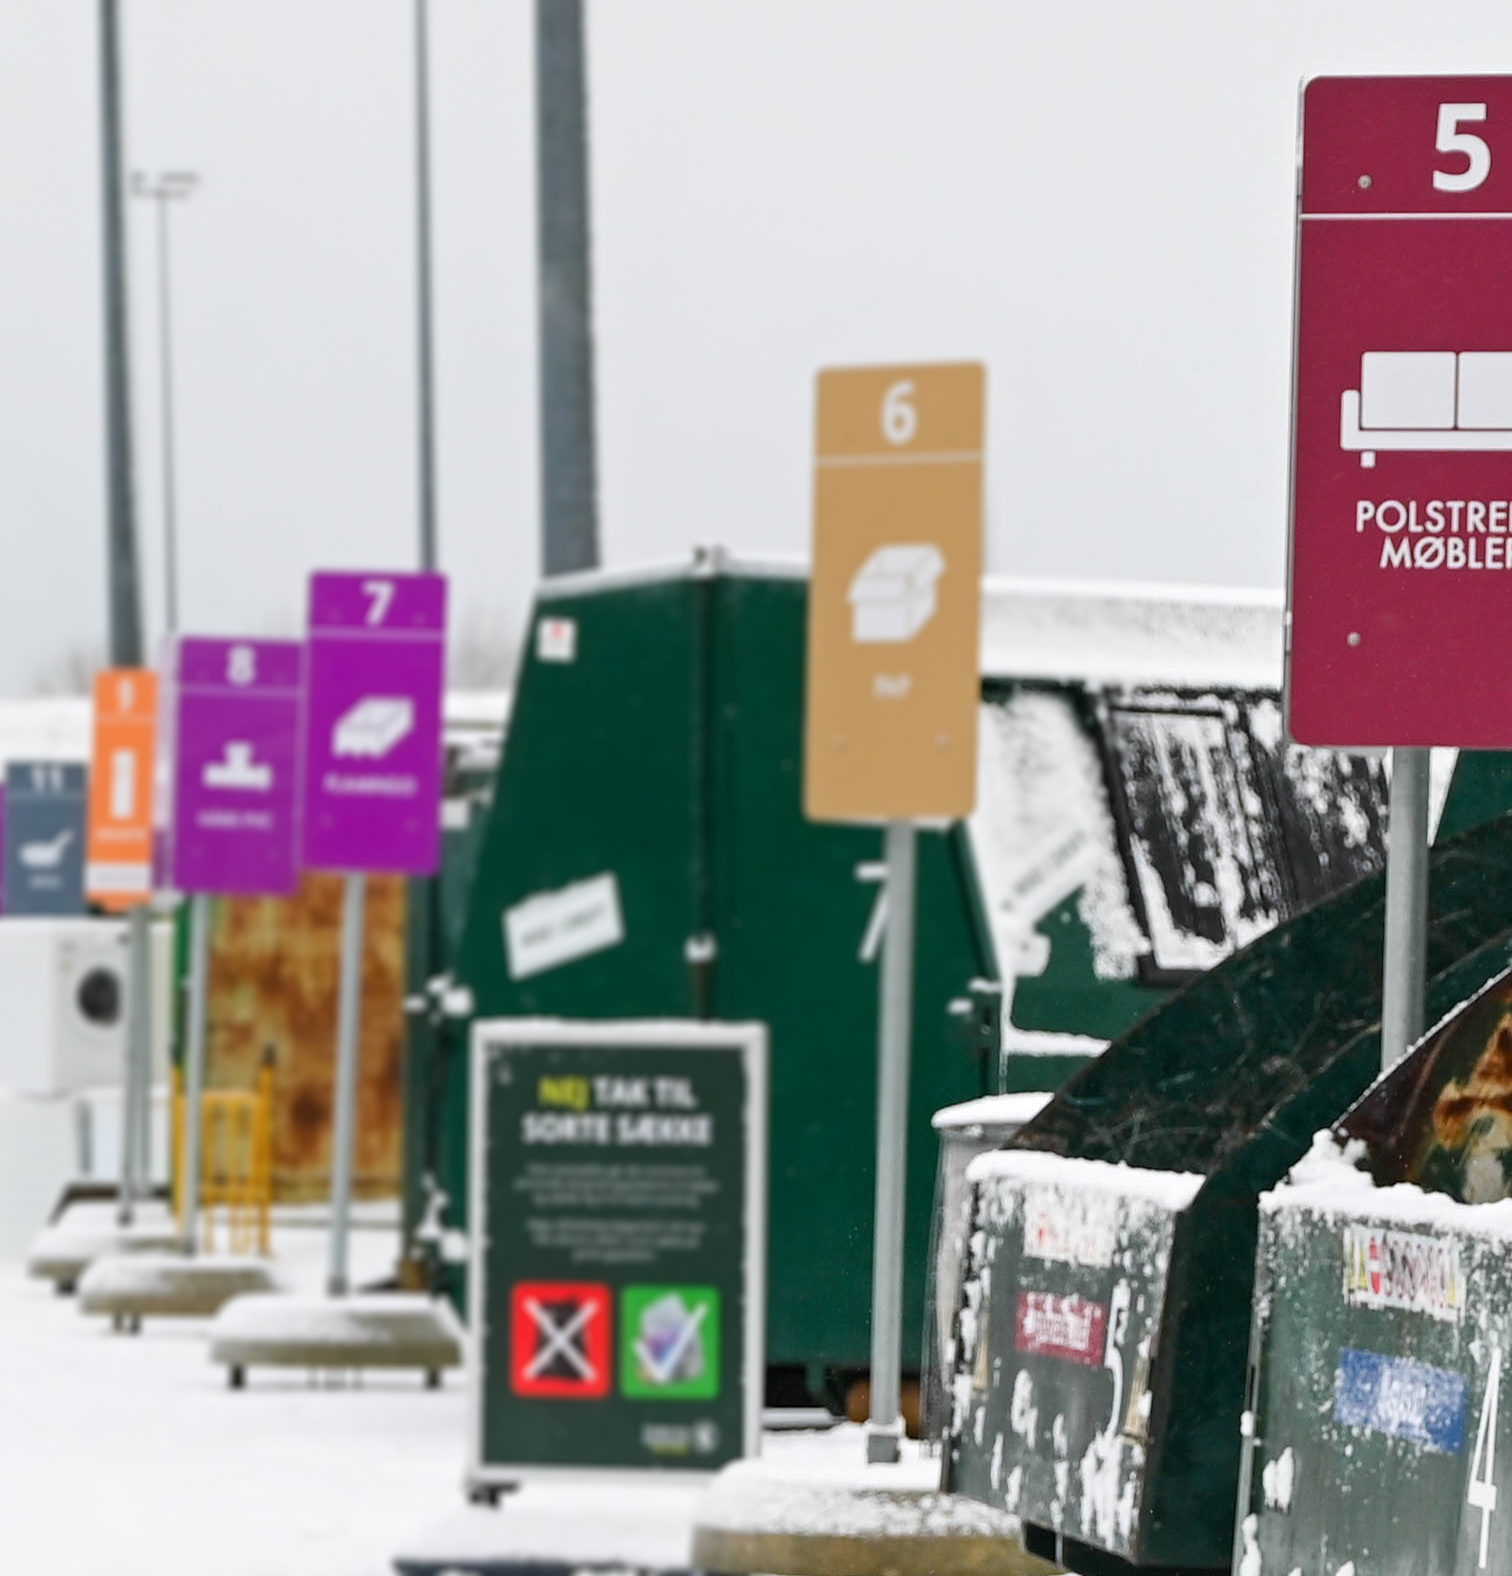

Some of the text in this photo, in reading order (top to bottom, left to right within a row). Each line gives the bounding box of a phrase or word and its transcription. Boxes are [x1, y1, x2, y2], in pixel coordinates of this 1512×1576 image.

[1433, 103, 1490, 191] 5
[882, 382, 916, 443] 6
[362, 581, 394, 626] 7
[227, 645, 256, 685] 8
[31, 767, 63, 792] 11
[539, 1077, 696, 1110] NEJ TAK TIL
[522, 1114, 712, 1145] SORTE SÆKKE
